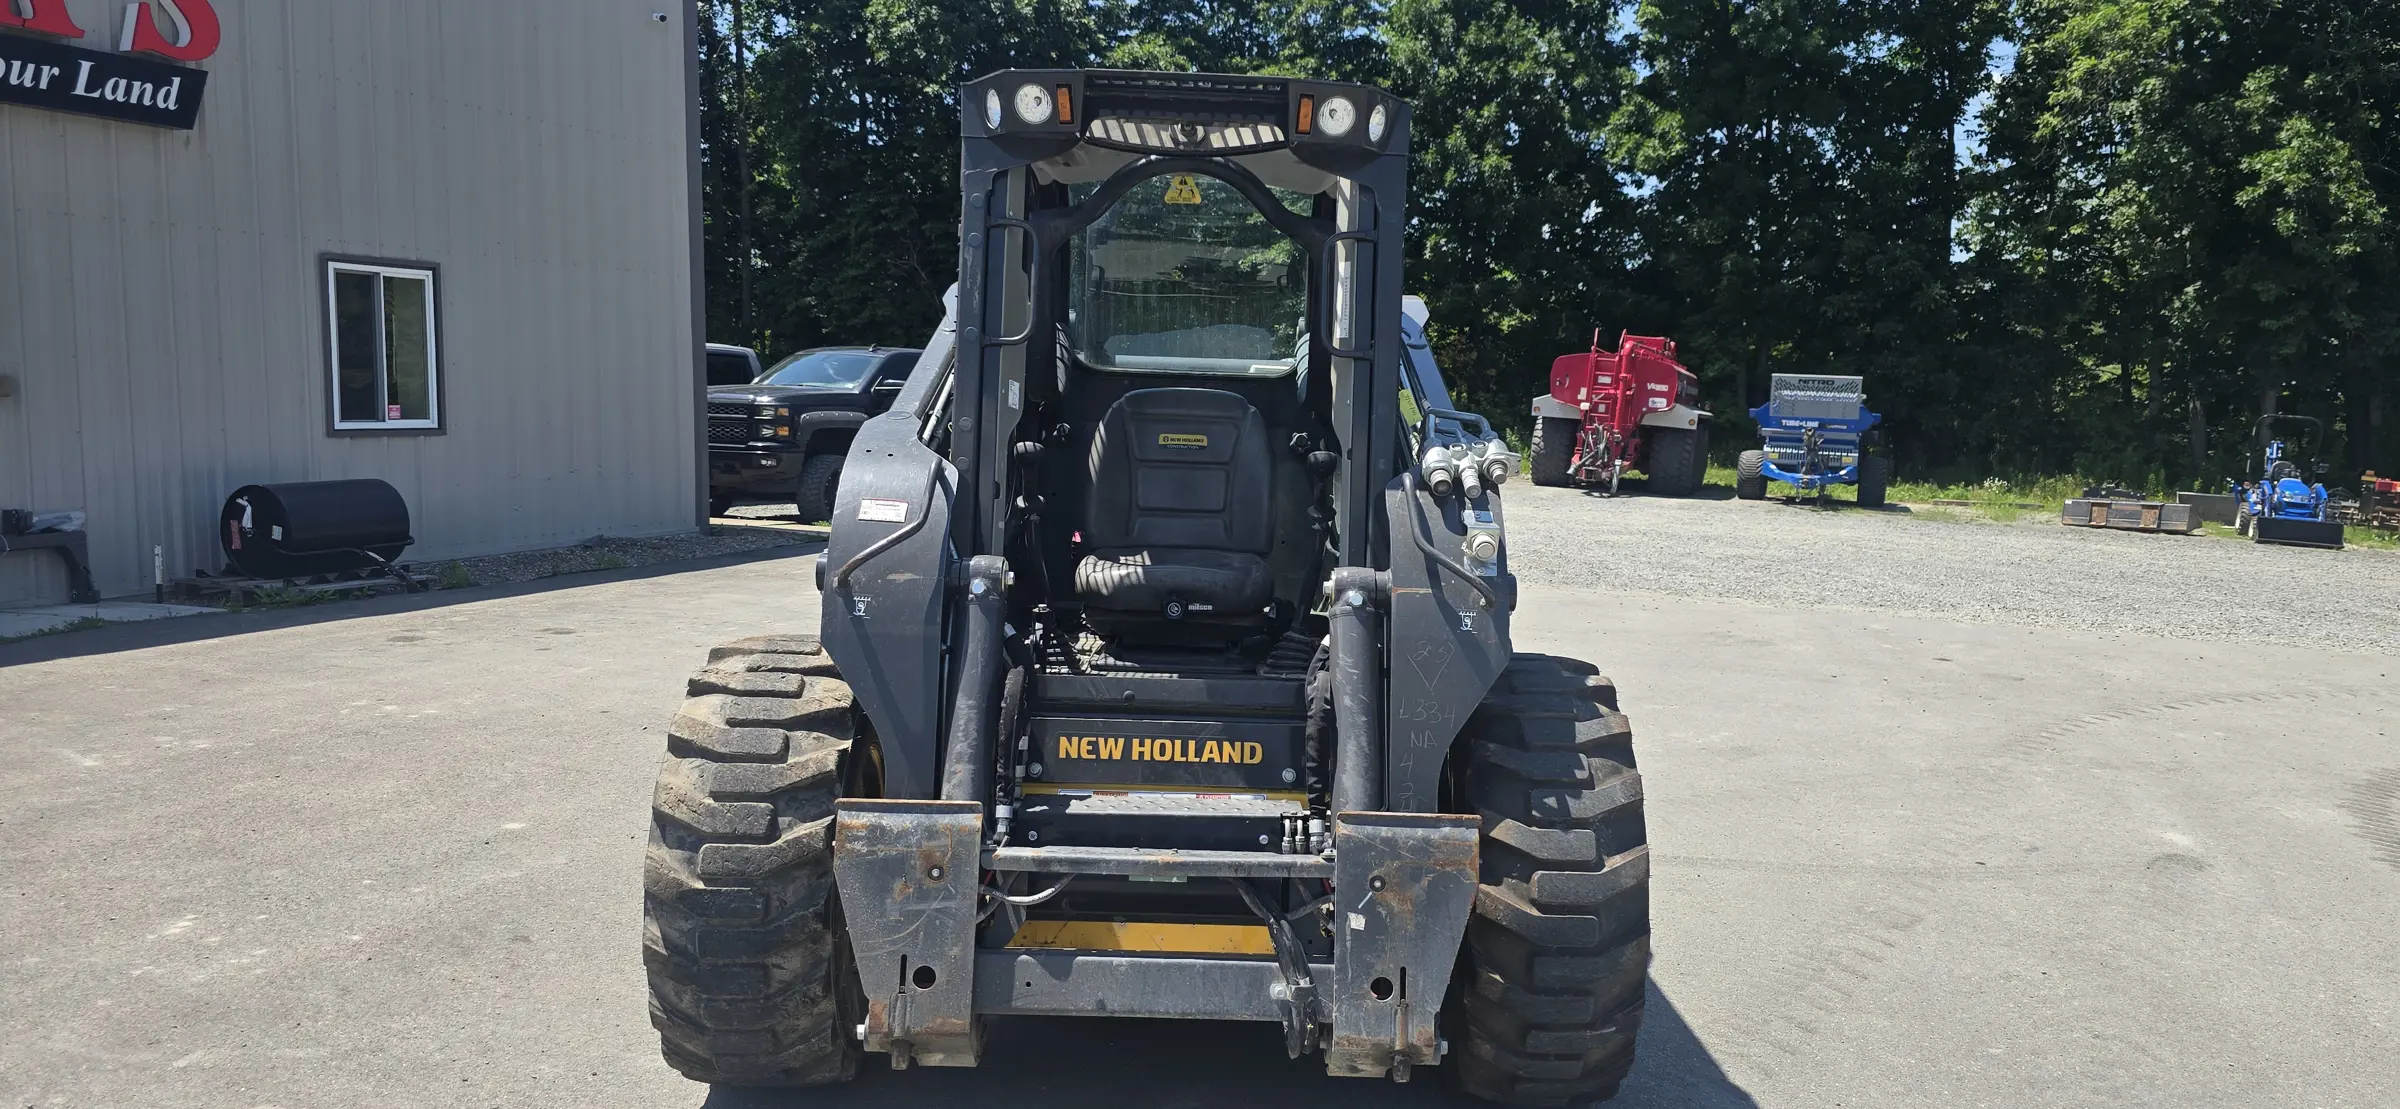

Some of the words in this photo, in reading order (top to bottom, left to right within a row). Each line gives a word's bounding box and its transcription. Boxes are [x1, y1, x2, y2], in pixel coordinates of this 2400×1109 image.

[0, 57, 60, 91] ur
[71, 59, 182, 111] Land
[1058, 736, 1125, 760] NEW
[1131, 738, 1264, 764] HOLLAND
